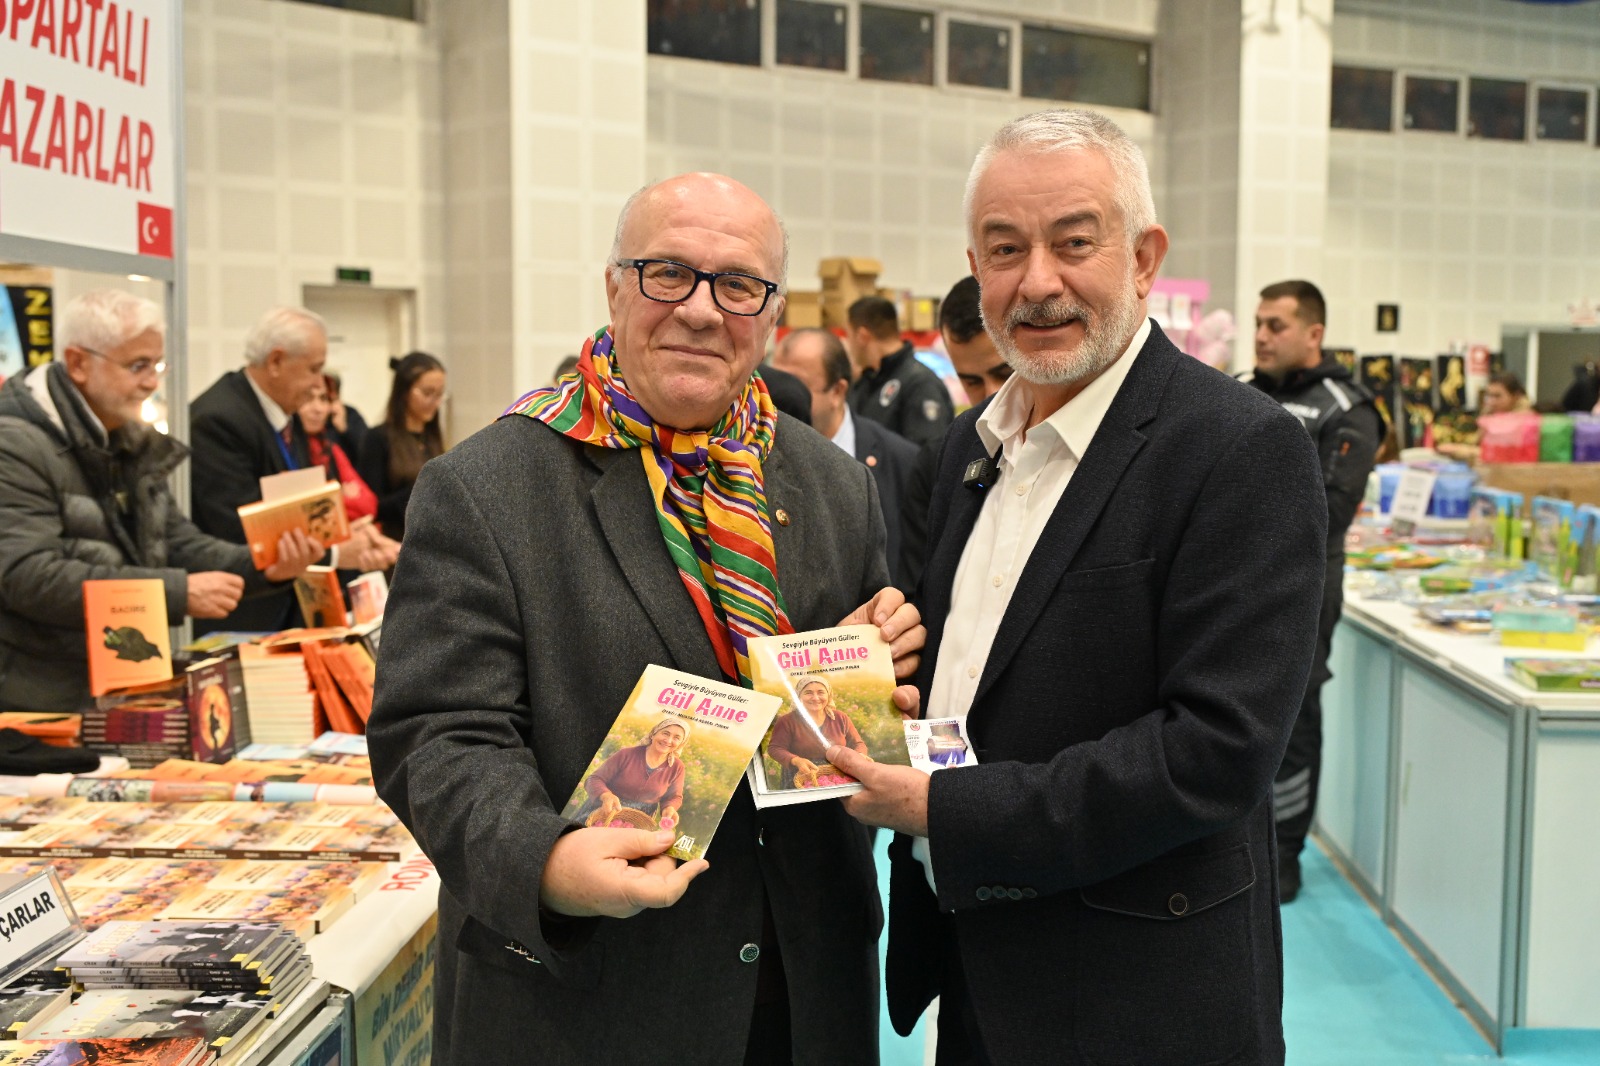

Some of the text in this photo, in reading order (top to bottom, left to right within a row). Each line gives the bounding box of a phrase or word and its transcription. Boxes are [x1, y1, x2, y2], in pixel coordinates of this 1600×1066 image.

[0, 0, 149, 87] PARTALI
[0, 77, 155, 193] AZARLAR
[777, 646, 869, 669] Gül Anne
[782, 634, 860, 649] Sevgiyle Büyüyen Güller:
[657, 687, 748, 723] Gül Anne
[673, 679, 749, 704] Sevgiyle Büyüyen Güller:
[0, 891, 56, 943] ÇARLAR
